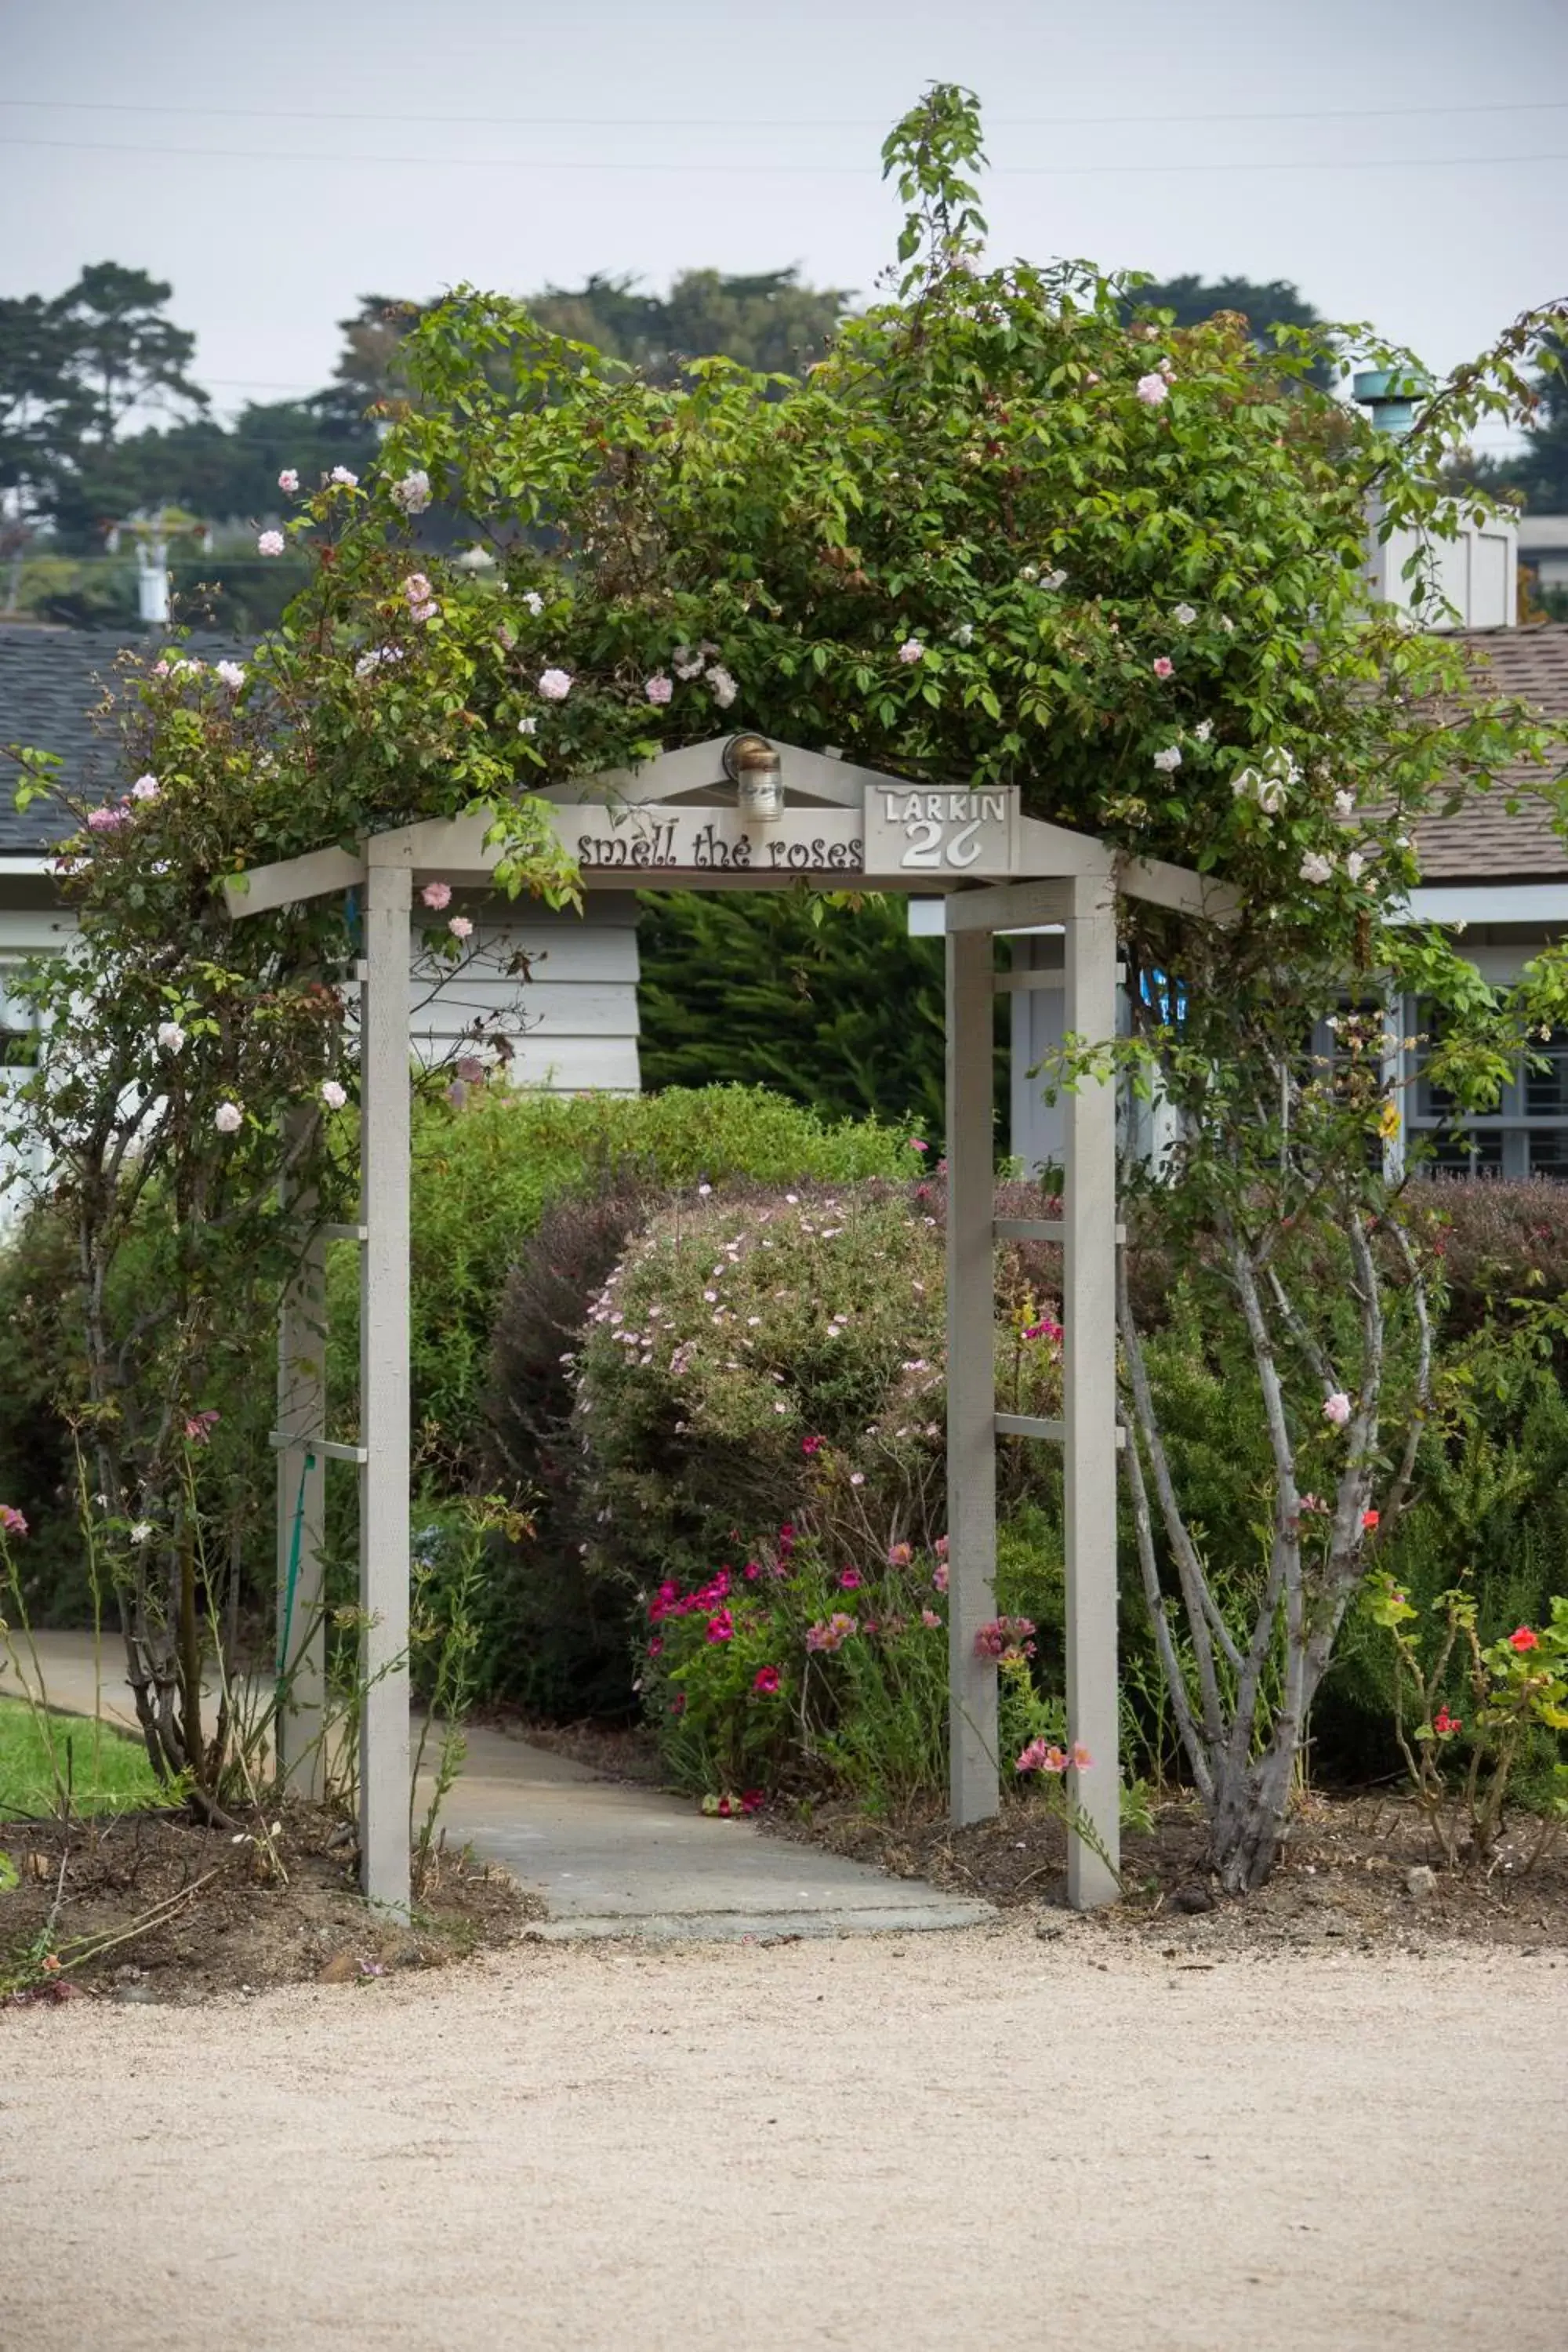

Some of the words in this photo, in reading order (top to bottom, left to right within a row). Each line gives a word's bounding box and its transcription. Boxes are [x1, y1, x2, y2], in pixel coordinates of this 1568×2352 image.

[886, 793, 1004, 822] LARKIN
[577, 824, 677, 866] smell
[691, 825, 753, 867] the
[766, 838, 863, 867] roses
[901, 819, 982, 869] 26
